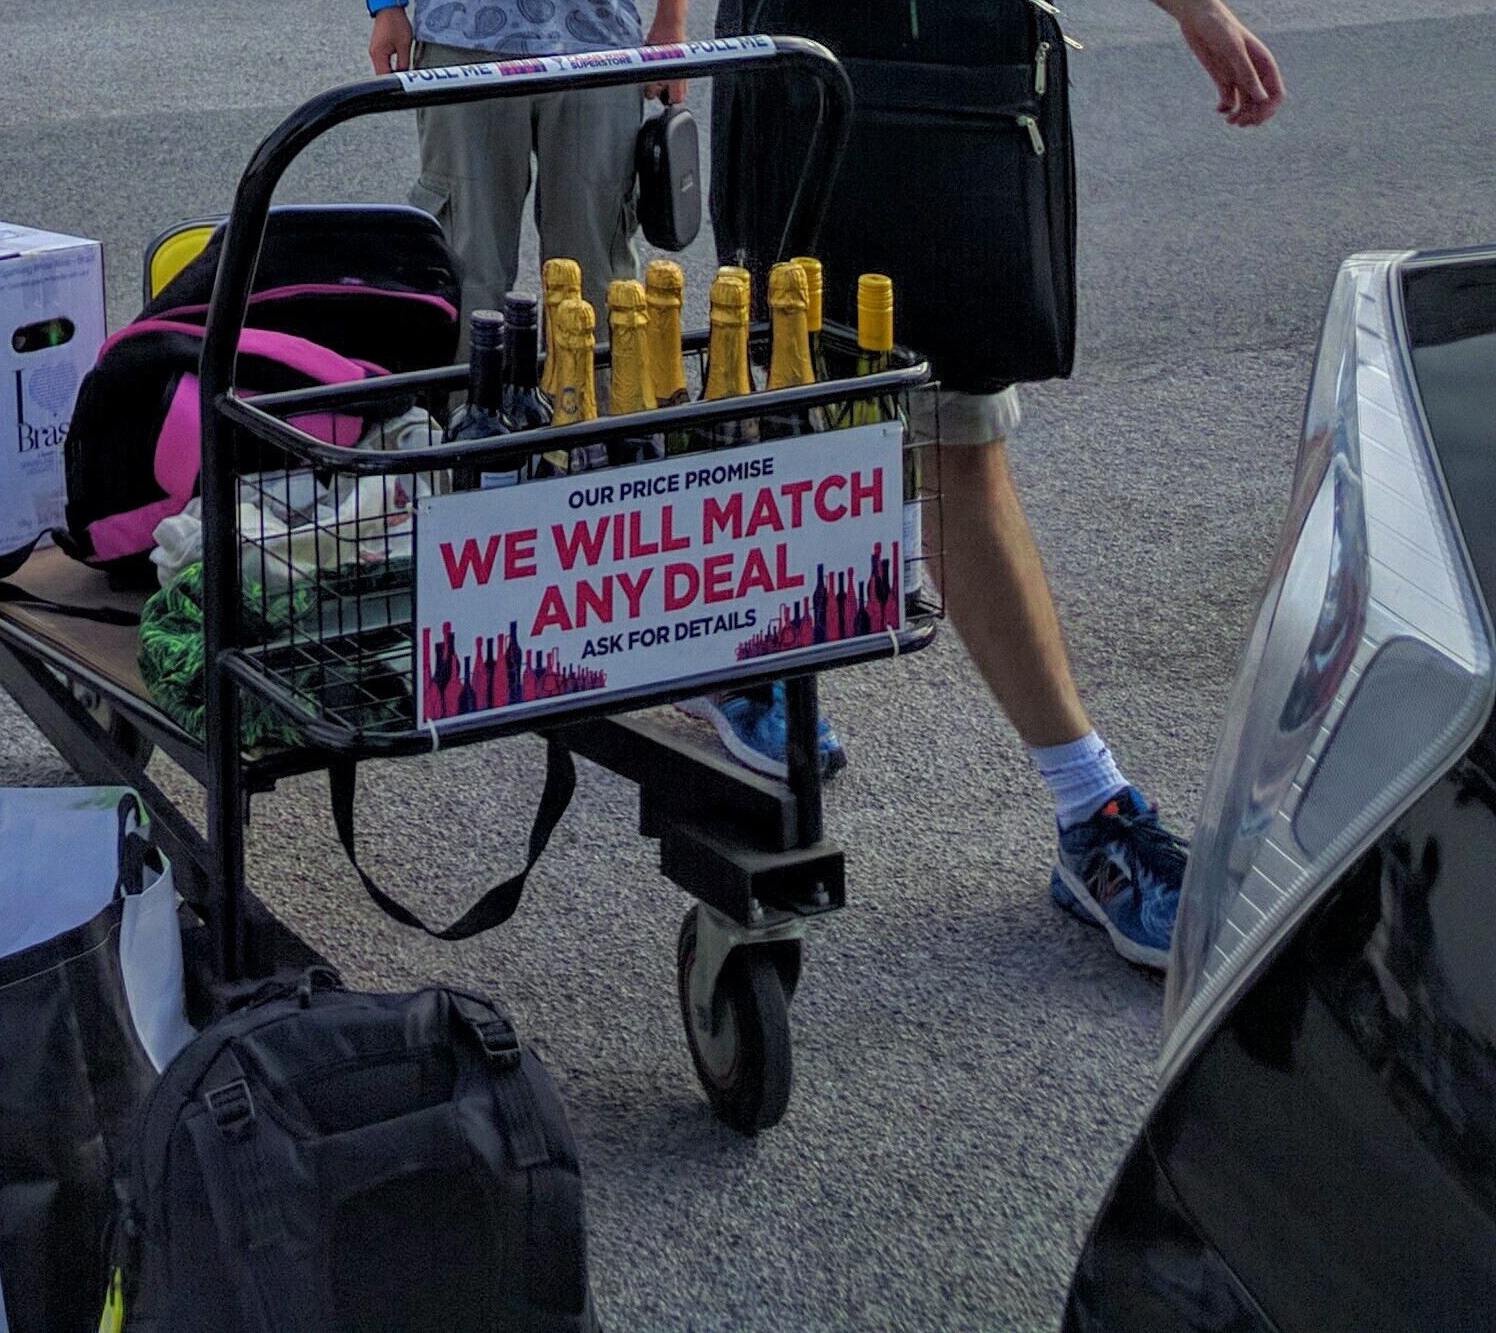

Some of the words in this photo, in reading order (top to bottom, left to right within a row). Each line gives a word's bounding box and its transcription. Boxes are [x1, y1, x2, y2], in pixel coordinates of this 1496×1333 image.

[571, 57, 632, 69] SUPERSTORE
[686, 40, 737, 54] PULL
[738, 35, 768, 49] ME
[404, 69, 459, 82] PULL
[459, 65, 492, 77] ME
[568, 484, 615, 509] OUR
[619, 475, 679, 502] PRICE
[684, 457, 774, 489] PROMISE
[439, 528, 538, 590] WE
[551, 505, 690, 571] WILL
[703, 467, 884, 545] MATCH
[530, 567, 654, 637] ANY
[663, 543, 804, 613] DEAL
[581, 634, 625, 660] ASK
[628, 628, 670, 653] FOR
[674, 608, 757, 644] DETAILS
